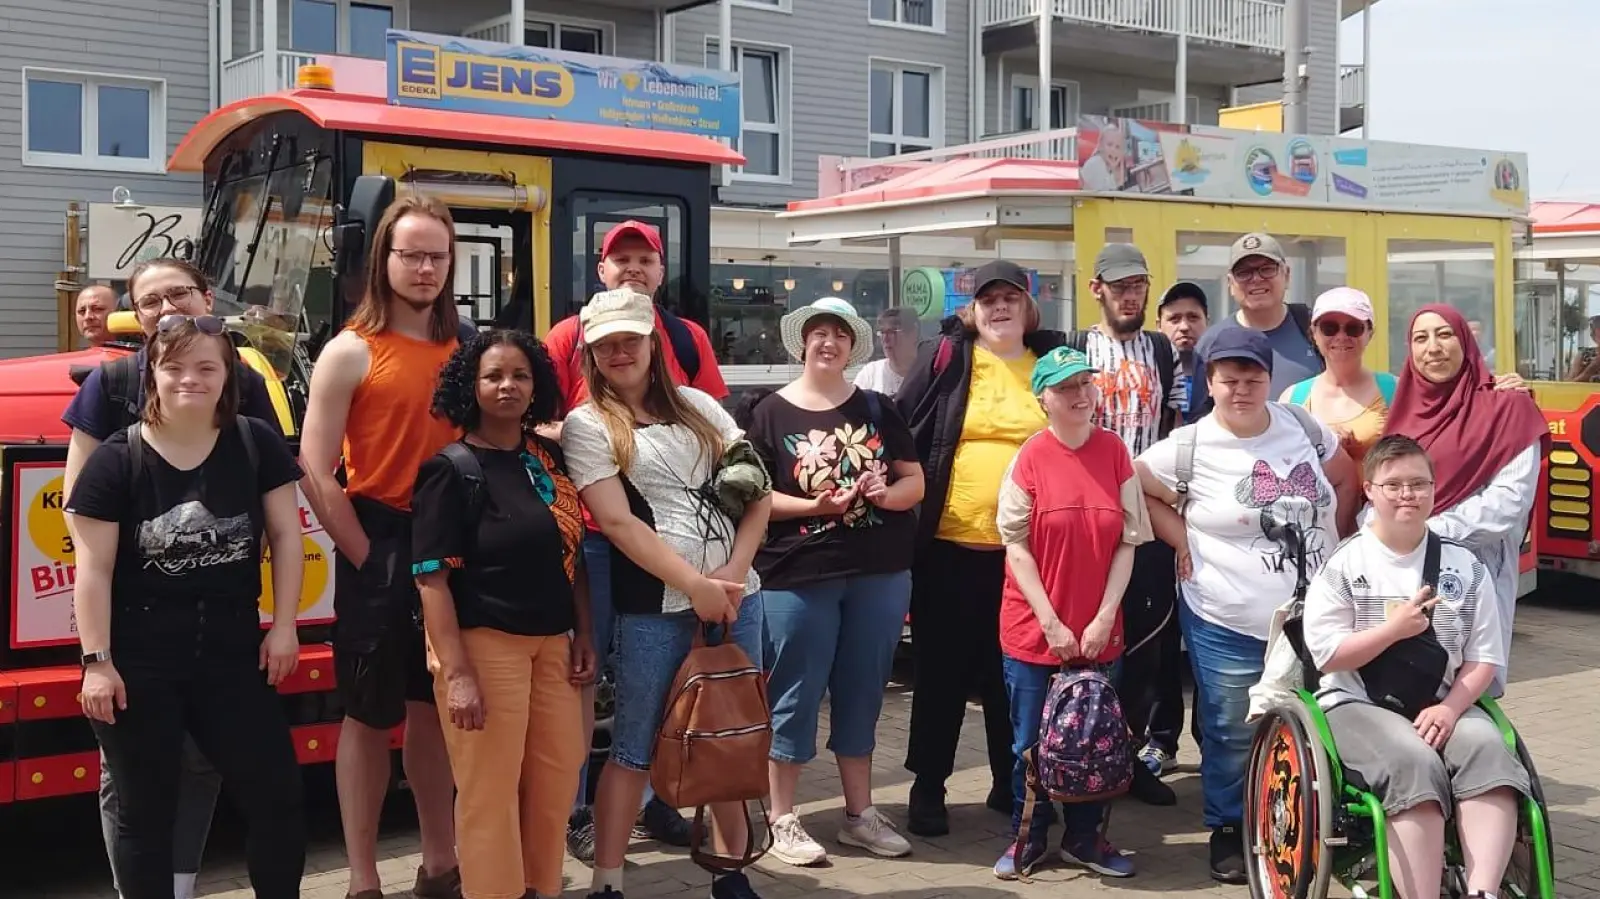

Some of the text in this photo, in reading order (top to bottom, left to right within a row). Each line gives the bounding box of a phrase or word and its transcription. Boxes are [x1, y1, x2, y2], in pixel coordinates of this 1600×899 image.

[401, 85, 437, 95] EDEKA
[447, 60, 563, 99] JENS
[596, 71, 722, 101] Wir Lebensmittel.
[42, 490, 63, 509] Ki
